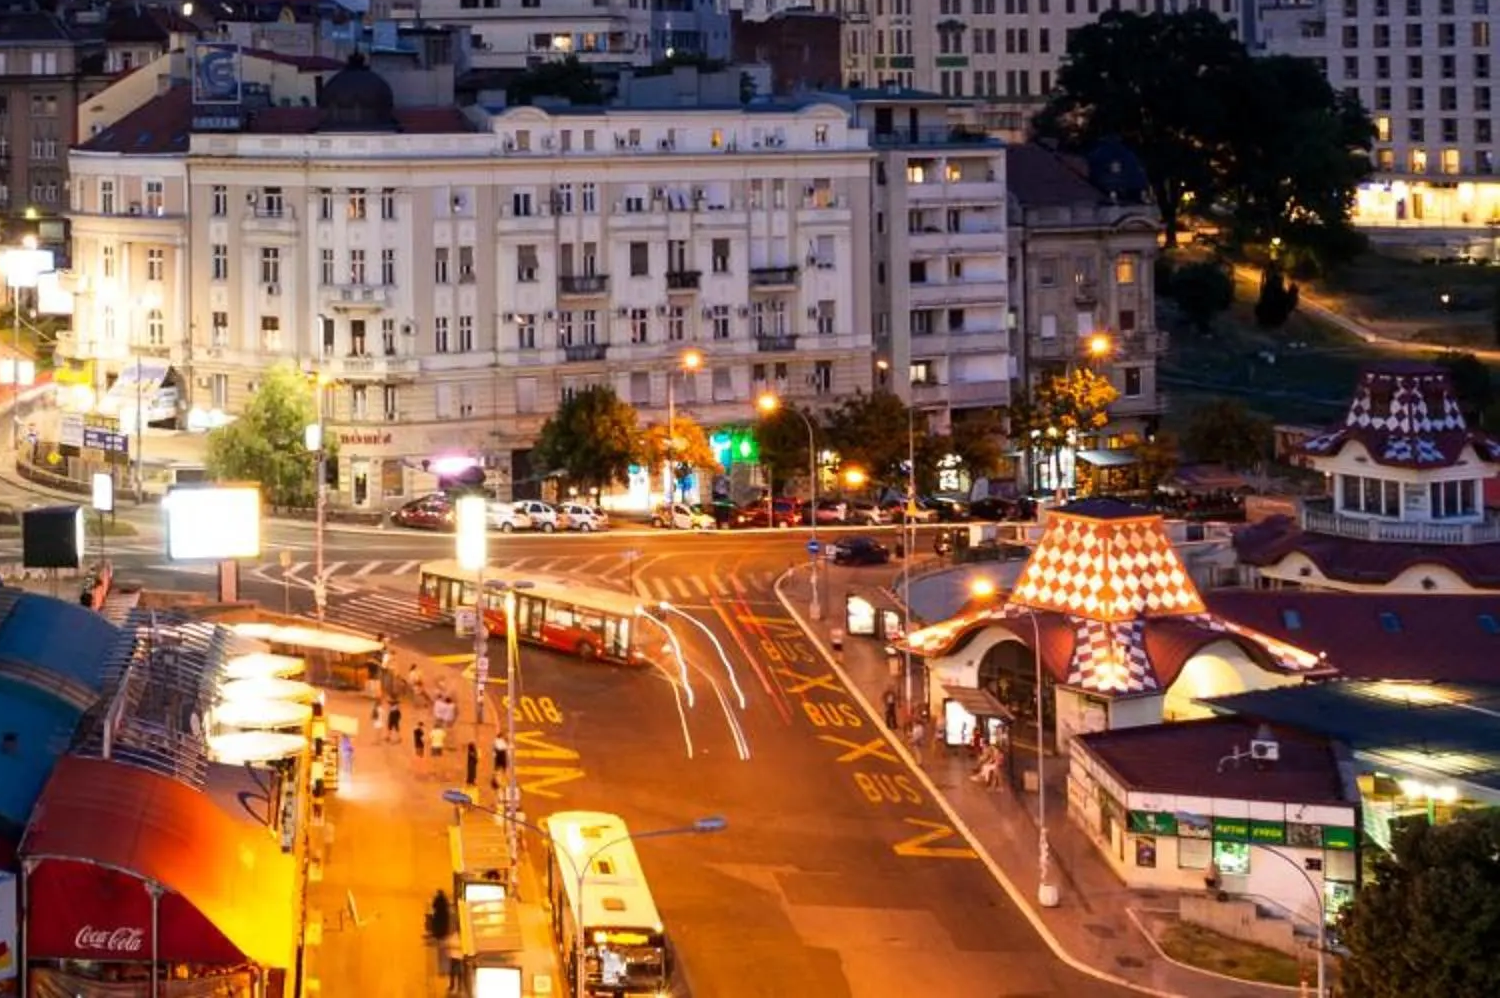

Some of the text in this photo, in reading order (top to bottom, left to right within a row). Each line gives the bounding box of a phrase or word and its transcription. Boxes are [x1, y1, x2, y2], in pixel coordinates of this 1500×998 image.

[759, 639, 816, 664] BUS
[802, 701, 863, 728] BUS
[853, 771, 923, 805] BUS
[74, 924, 144, 951] Coca-Cola
